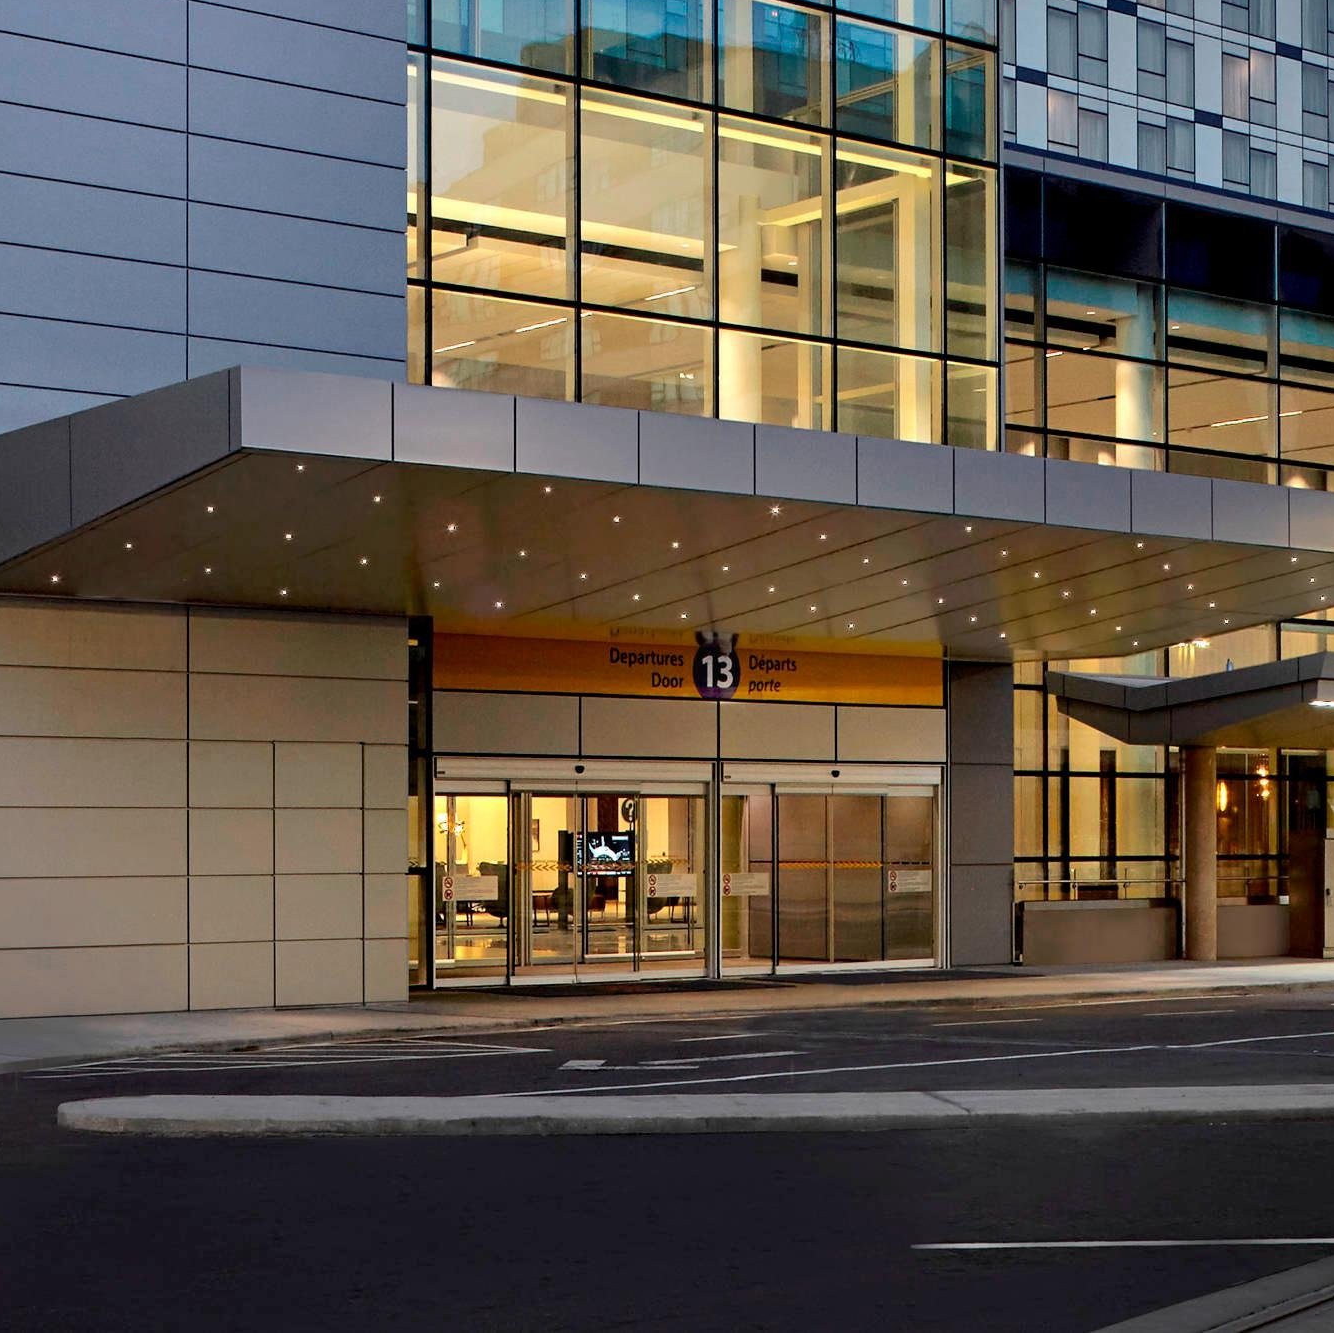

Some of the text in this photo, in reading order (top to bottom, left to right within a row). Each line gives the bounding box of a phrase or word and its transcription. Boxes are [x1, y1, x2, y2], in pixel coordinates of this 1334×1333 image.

[609, 647, 685, 668] Departures
[748, 654, 798, 674] Départs
[651, 672, 684, 688] Door
[701, 655, 734, 689] 13
[748, 677, 782, 695] porte
